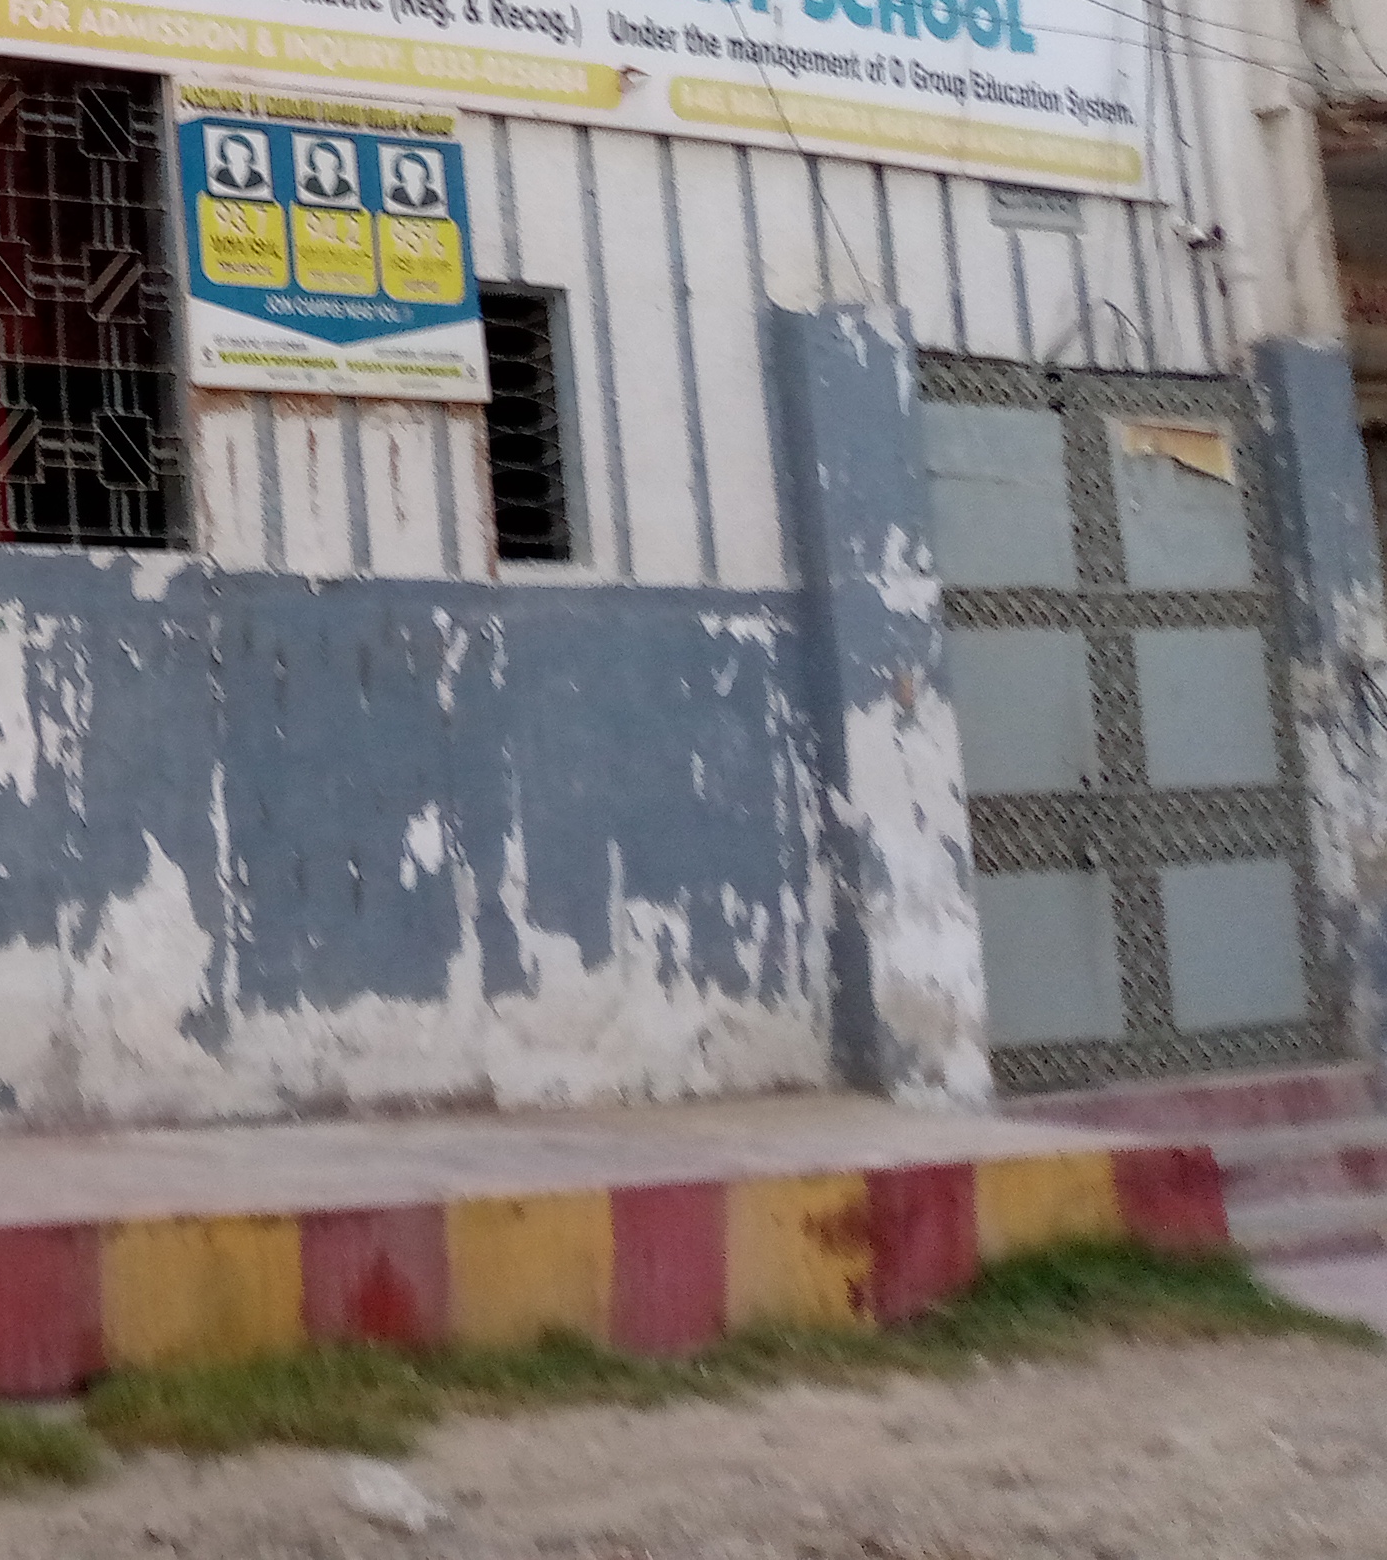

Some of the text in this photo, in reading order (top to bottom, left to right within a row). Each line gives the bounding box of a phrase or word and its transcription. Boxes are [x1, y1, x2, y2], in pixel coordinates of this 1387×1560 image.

[607, 8, 679, 53] Under
[683, 22, 723, 60] the
[727, 36, 863, 80] management
[865, 52, 887, 85] of
[909, 57, 968, 107] Group
[968, 68, 1063, 115] Education
